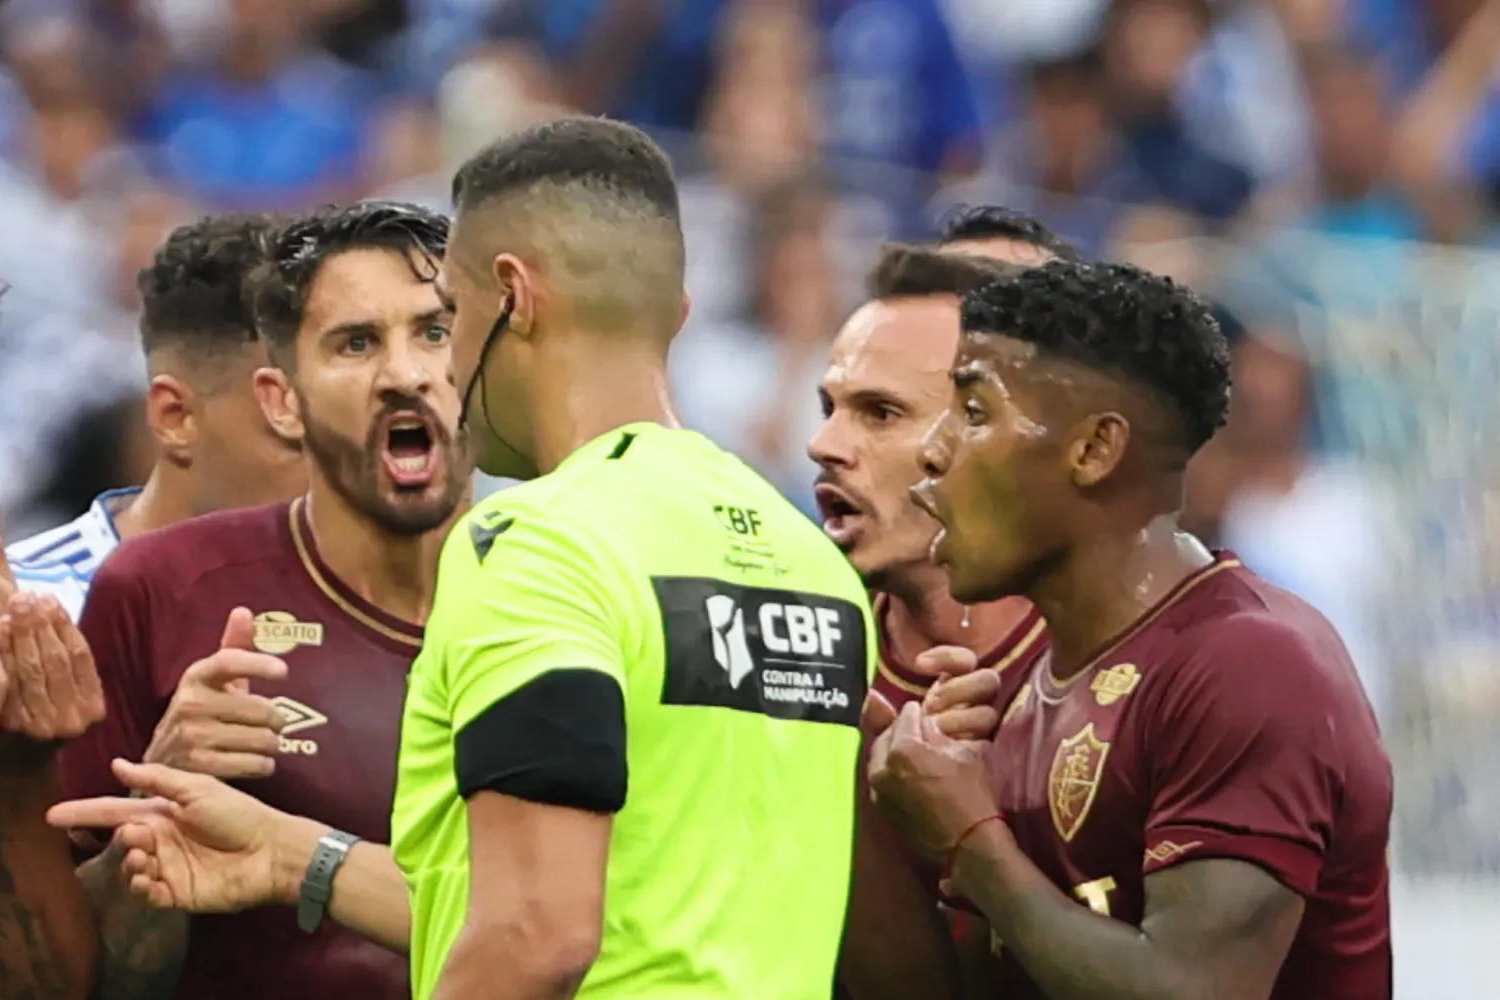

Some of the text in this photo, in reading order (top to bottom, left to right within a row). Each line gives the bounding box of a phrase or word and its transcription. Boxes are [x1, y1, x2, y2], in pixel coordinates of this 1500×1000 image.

[759, 602, 842, 657] CBF
[762, 669, 825, 688] CONTRA A
[763, 687, 849, 709] MANIPULAÇÃO
[278, 734, 318, 755] bro
